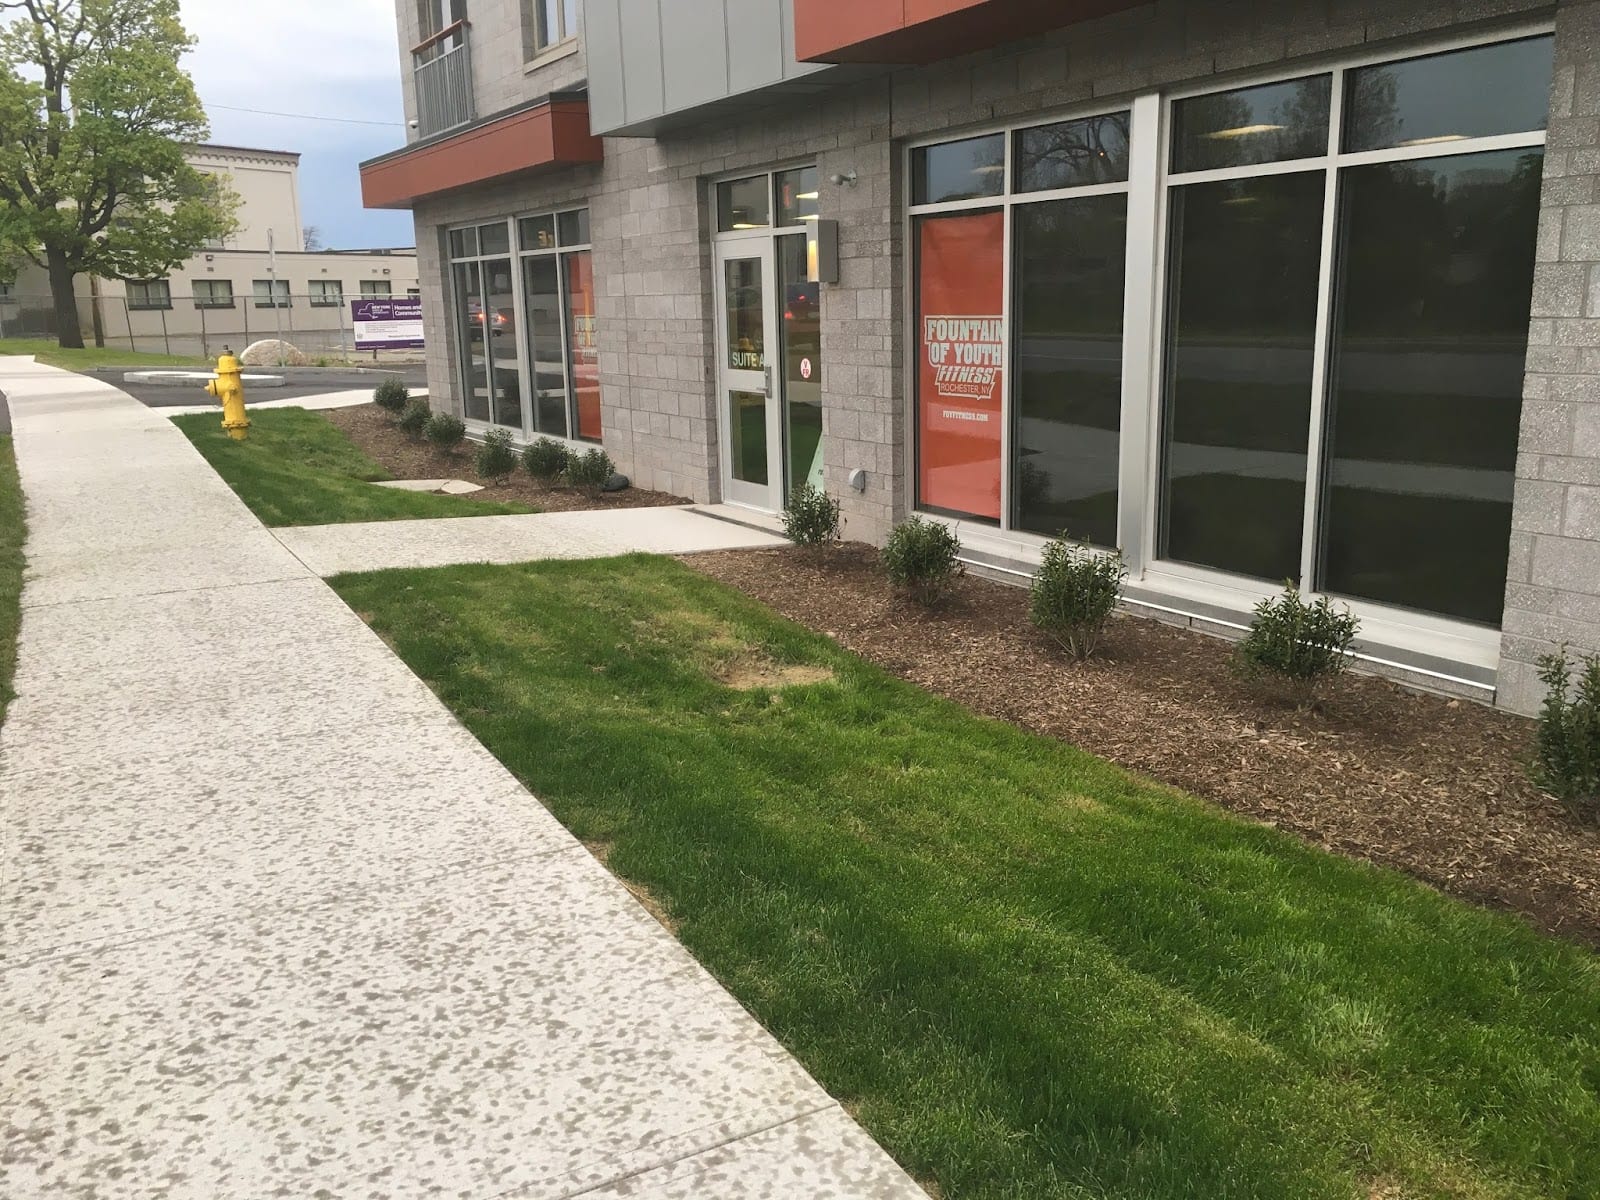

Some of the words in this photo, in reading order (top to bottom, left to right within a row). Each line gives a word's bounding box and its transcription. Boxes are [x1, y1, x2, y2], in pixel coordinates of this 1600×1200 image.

[927, 320, 1002, 342] FOUNTAIN
[732, 351, 757, 367] SUITE
[759, 353, 764, 367] A
[930, 342, 950, 364] OF
[954, 342, 1002, 366] YOUTH
[938, 366, 994, 384] FITNESS
[940, 383, 980, 394] ROCHESTER,
[981, 385, 990, 394] NY
